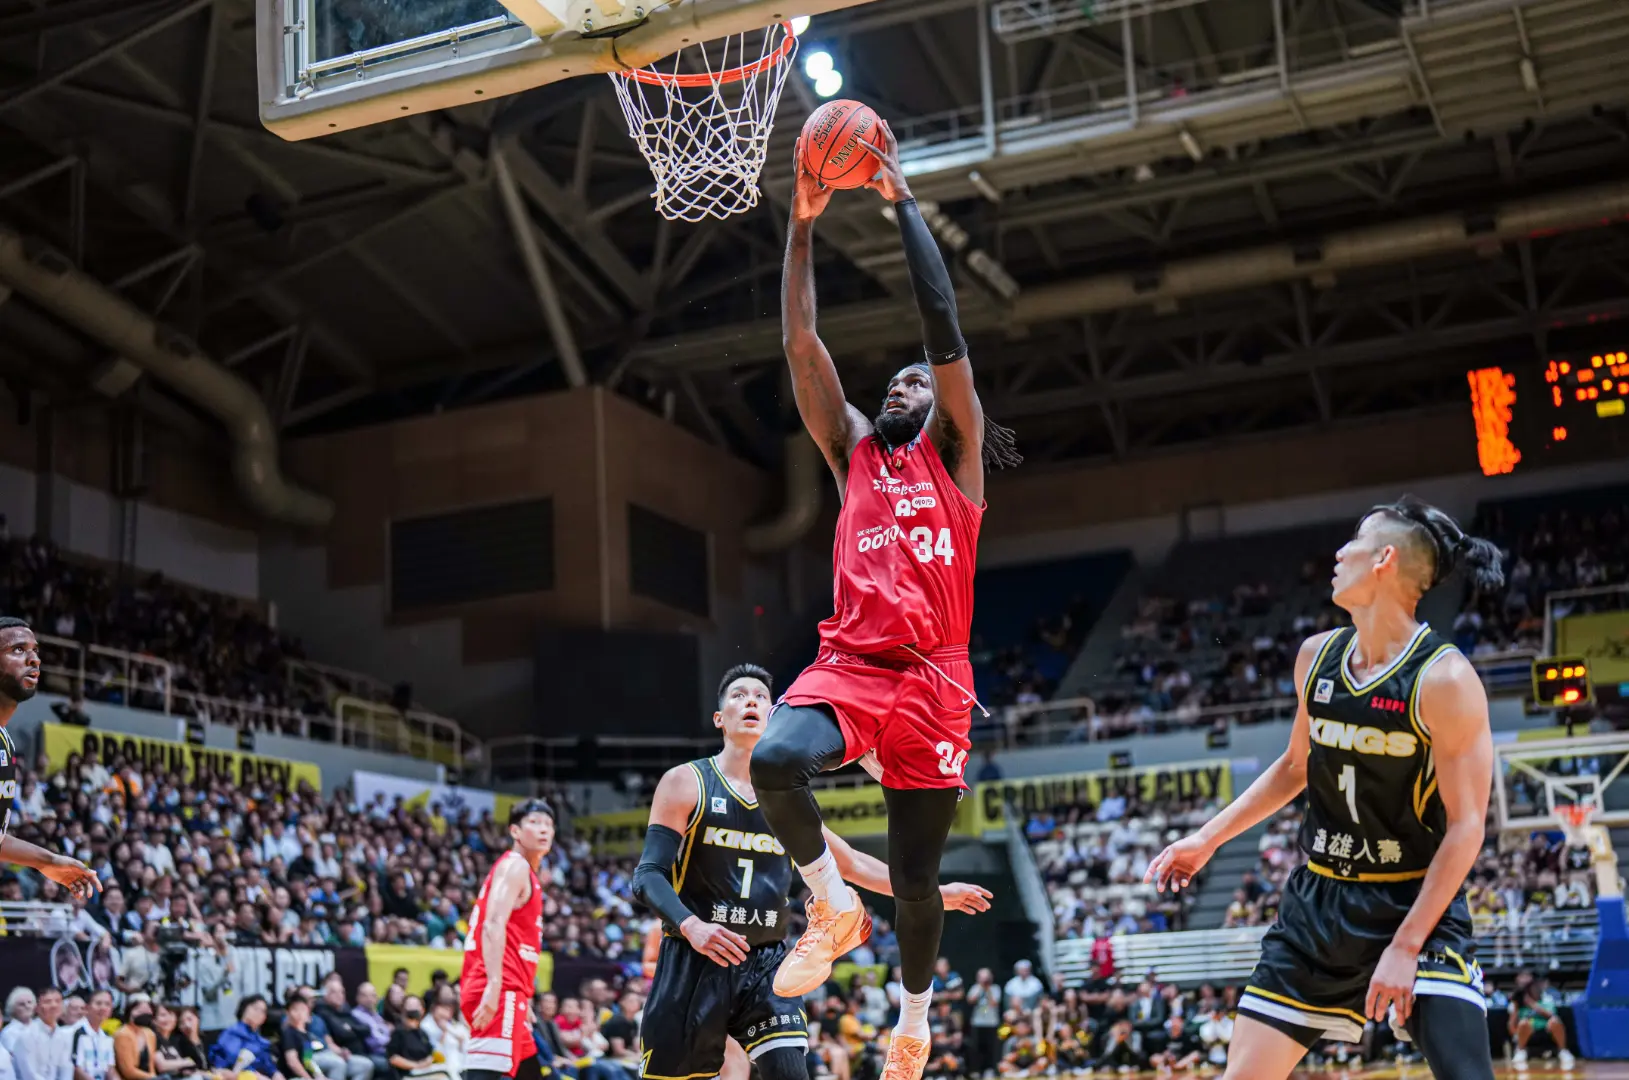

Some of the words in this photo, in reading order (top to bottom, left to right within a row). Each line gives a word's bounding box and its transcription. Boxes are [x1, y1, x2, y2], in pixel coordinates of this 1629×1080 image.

[819, 105, 850, 151] LEGACY
[910, 526, 954, 566] 34
[1309, 716, 1418, 758] KINGS
[737, 857, 754, 899] 7
[711, 904, 778, 928] 遠雄人壽
[759, 1014, 801, 1031] 王道銀行
